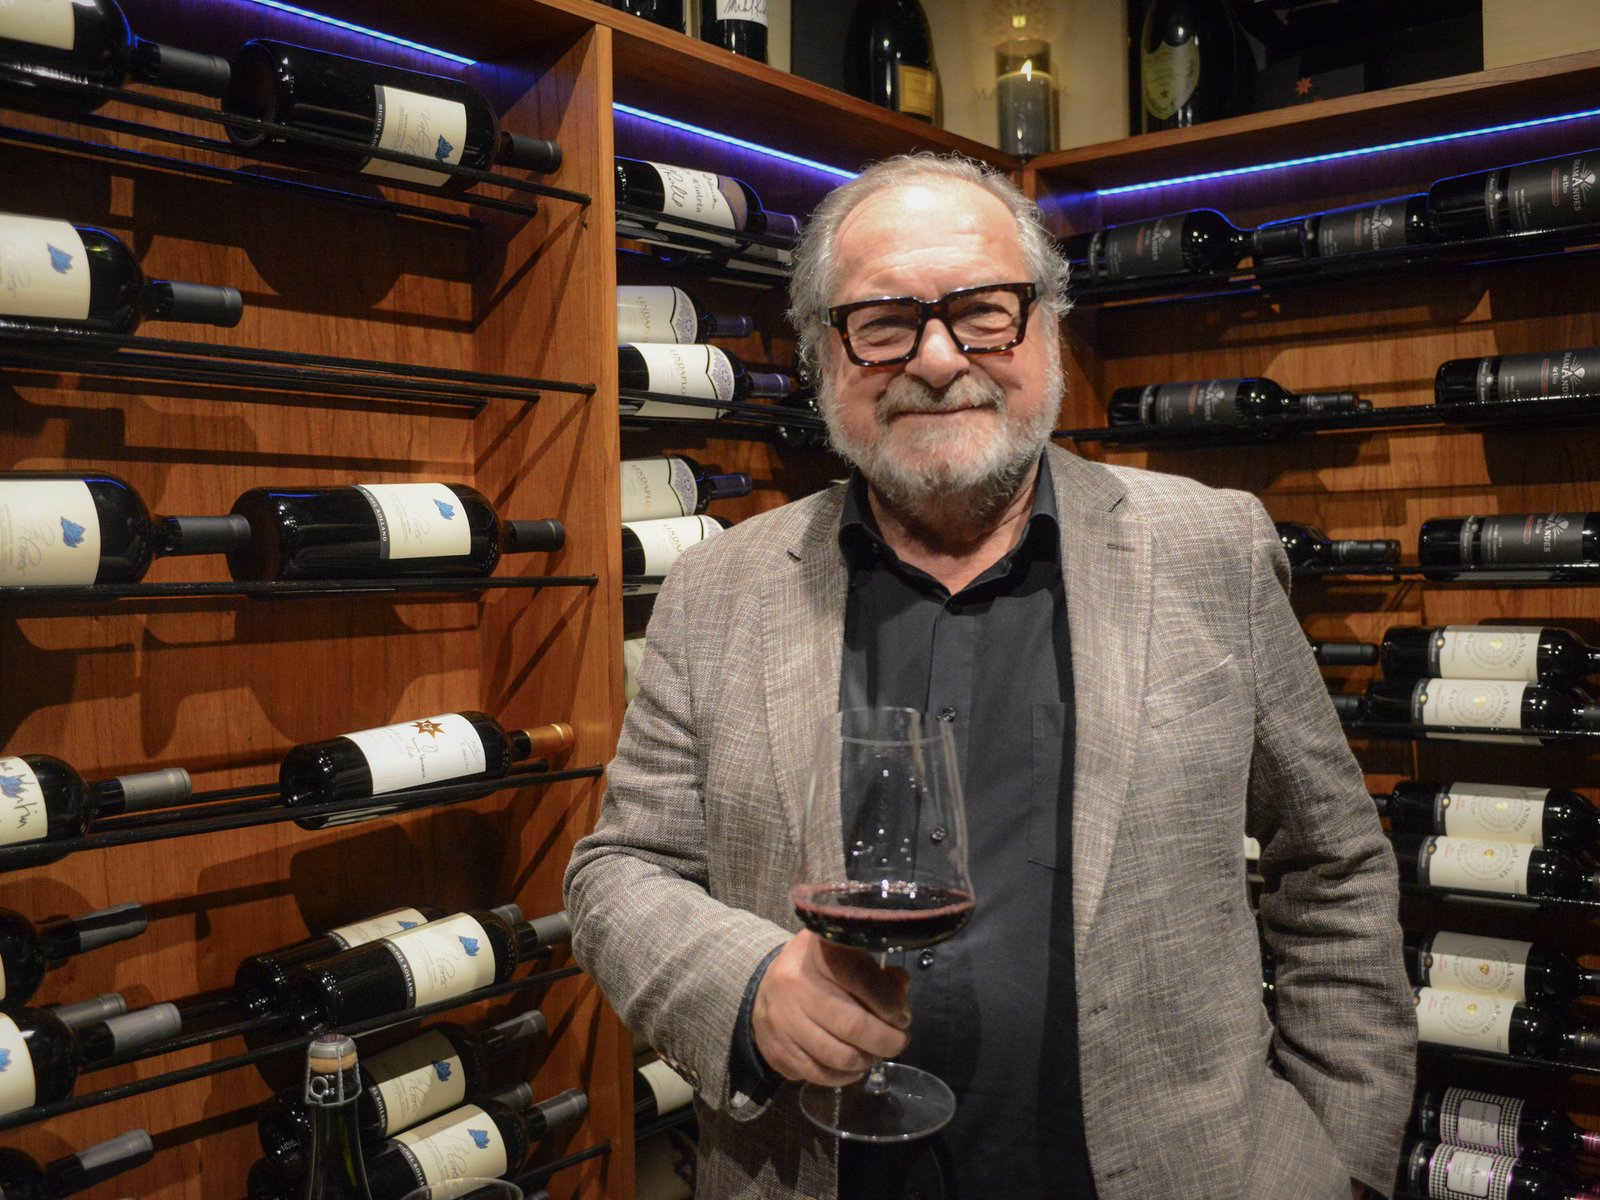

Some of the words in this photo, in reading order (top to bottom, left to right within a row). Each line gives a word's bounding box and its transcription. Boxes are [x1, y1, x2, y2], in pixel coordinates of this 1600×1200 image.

[374, 103, 384, 132] MICHEL
[670, 348, 688, 395] LINDAFLO
[376, 509, 388, 542] ROLLAND
[387, 943, 404, 966] MICHEL
[402, 965, 413, 997] ROLLAND
[376, 1097, 386, 1128] ROLLAND
[397, 1143, 416, 1163] MICHEL
